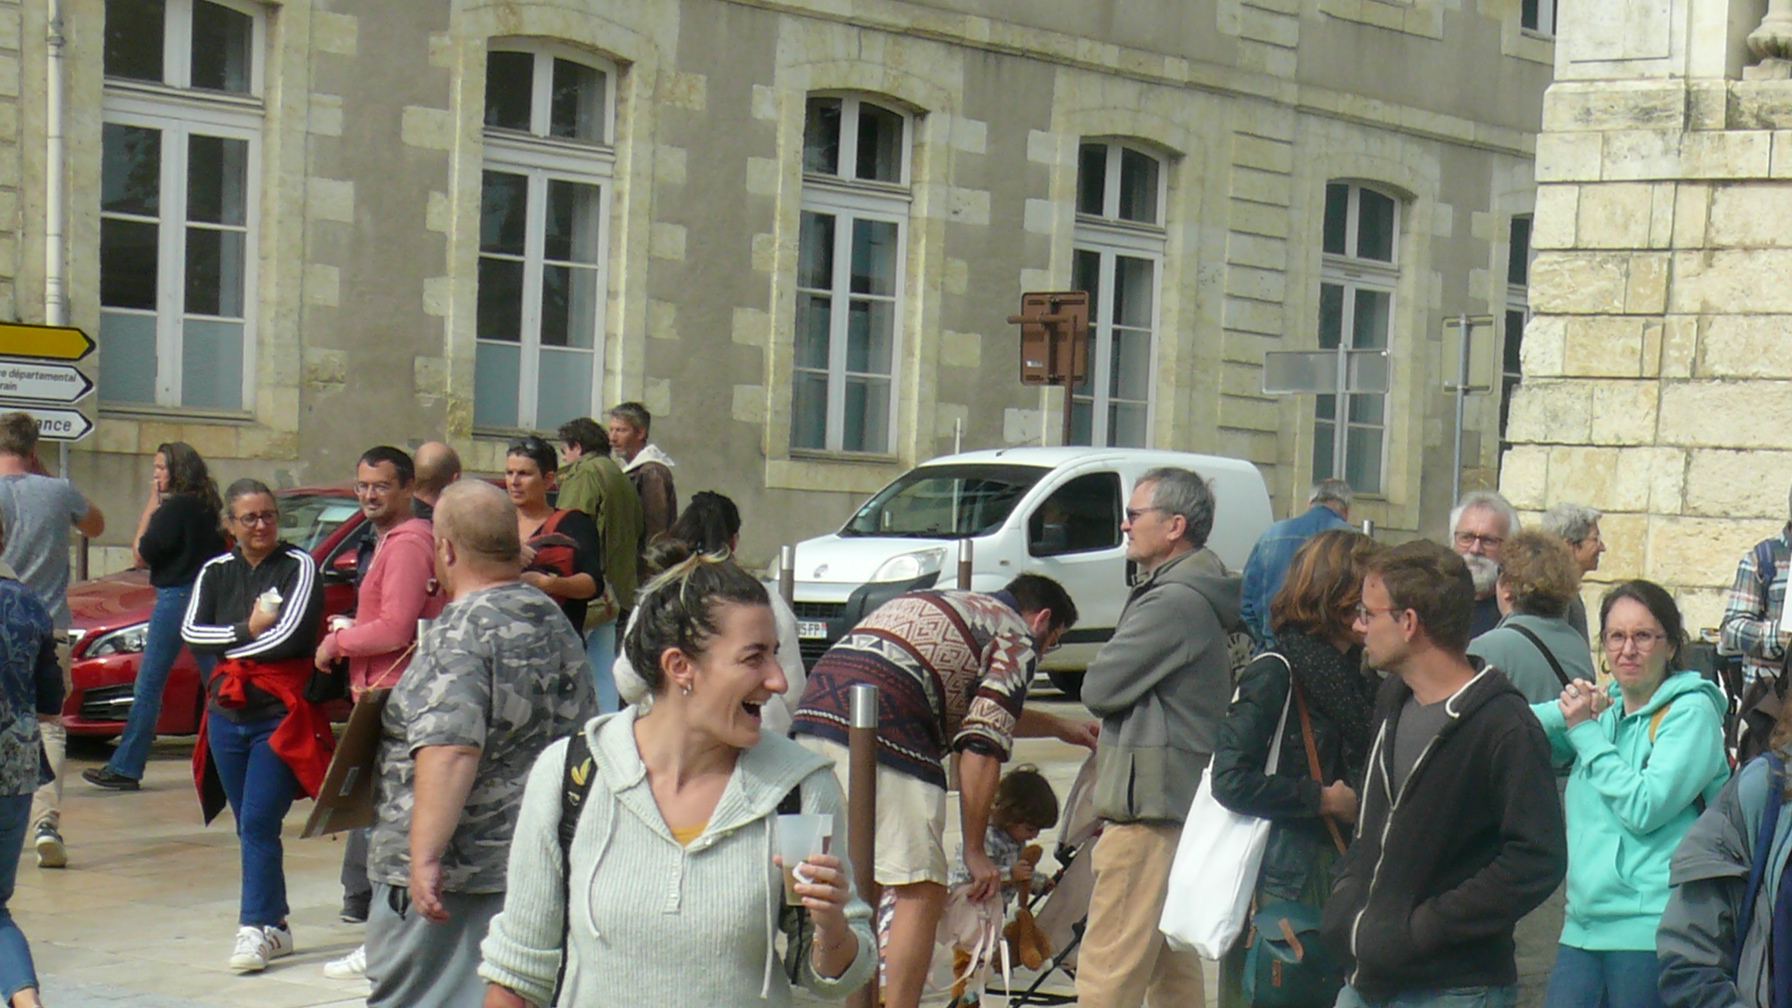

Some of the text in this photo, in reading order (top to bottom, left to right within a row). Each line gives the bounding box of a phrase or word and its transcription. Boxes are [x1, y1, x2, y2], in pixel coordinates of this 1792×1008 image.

[9, 367, 77, 383] départemental
[0, 381, 17, 391] rain
[36, 418, 72, 432] ance
